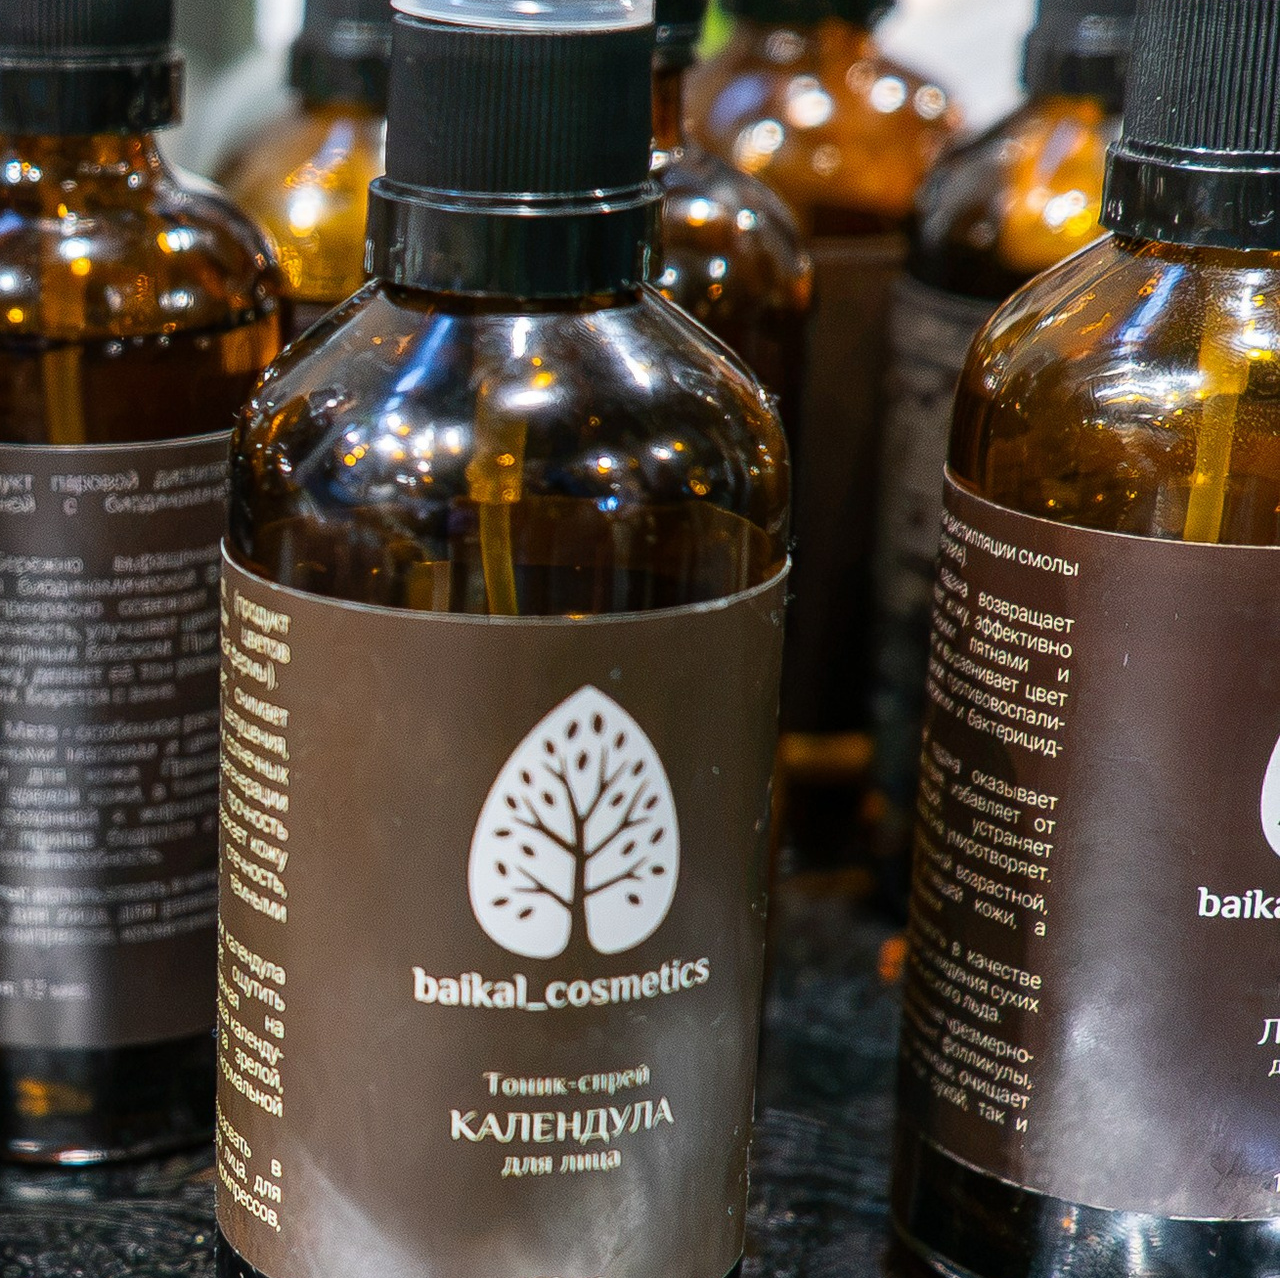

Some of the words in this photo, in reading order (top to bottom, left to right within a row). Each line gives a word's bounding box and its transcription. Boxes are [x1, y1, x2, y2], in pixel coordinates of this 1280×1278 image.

[1019, 549, 1080, 577] смолы
[978, 591, 1075, 634] возвращает
[974, 614, 1073, 660] эффективно
[970, 636, 1030, 674] пятнами
[1057, 667, 1070, 684] и
[1025, 684, 1068, 709] цвет
[967, 707, 1064, 759] бактерицид-
[972, 770, 1059, 811] оказывает
[972, 818, 1054, 859] устраняет
[1034, 818, 1057, 835] от
[974, 899, 1018, 931] кожи,
[1034, 920, 1046, 938] а
[413, 958, 710, 1011] baikal_cosmetics
[967, 949, 1042, 990] качестве
[990, 983, 1040, 1015] сухих
[265, 1014, 286, 1040] на
[483, 1064, 651, 1097] Тоник-спрей
[958, 1069, 1031, 1111] очищает
[451, 1097, 674, 1145] КАЛЕНДУЛА
[1015, 1116, 1029, 1134] и
[271, 1158, 283, 1179] в
[502, 1157, 553, 1179] для
[560, 1149, 622, 1174] лица
[253, 1174, 282, 1204] для
